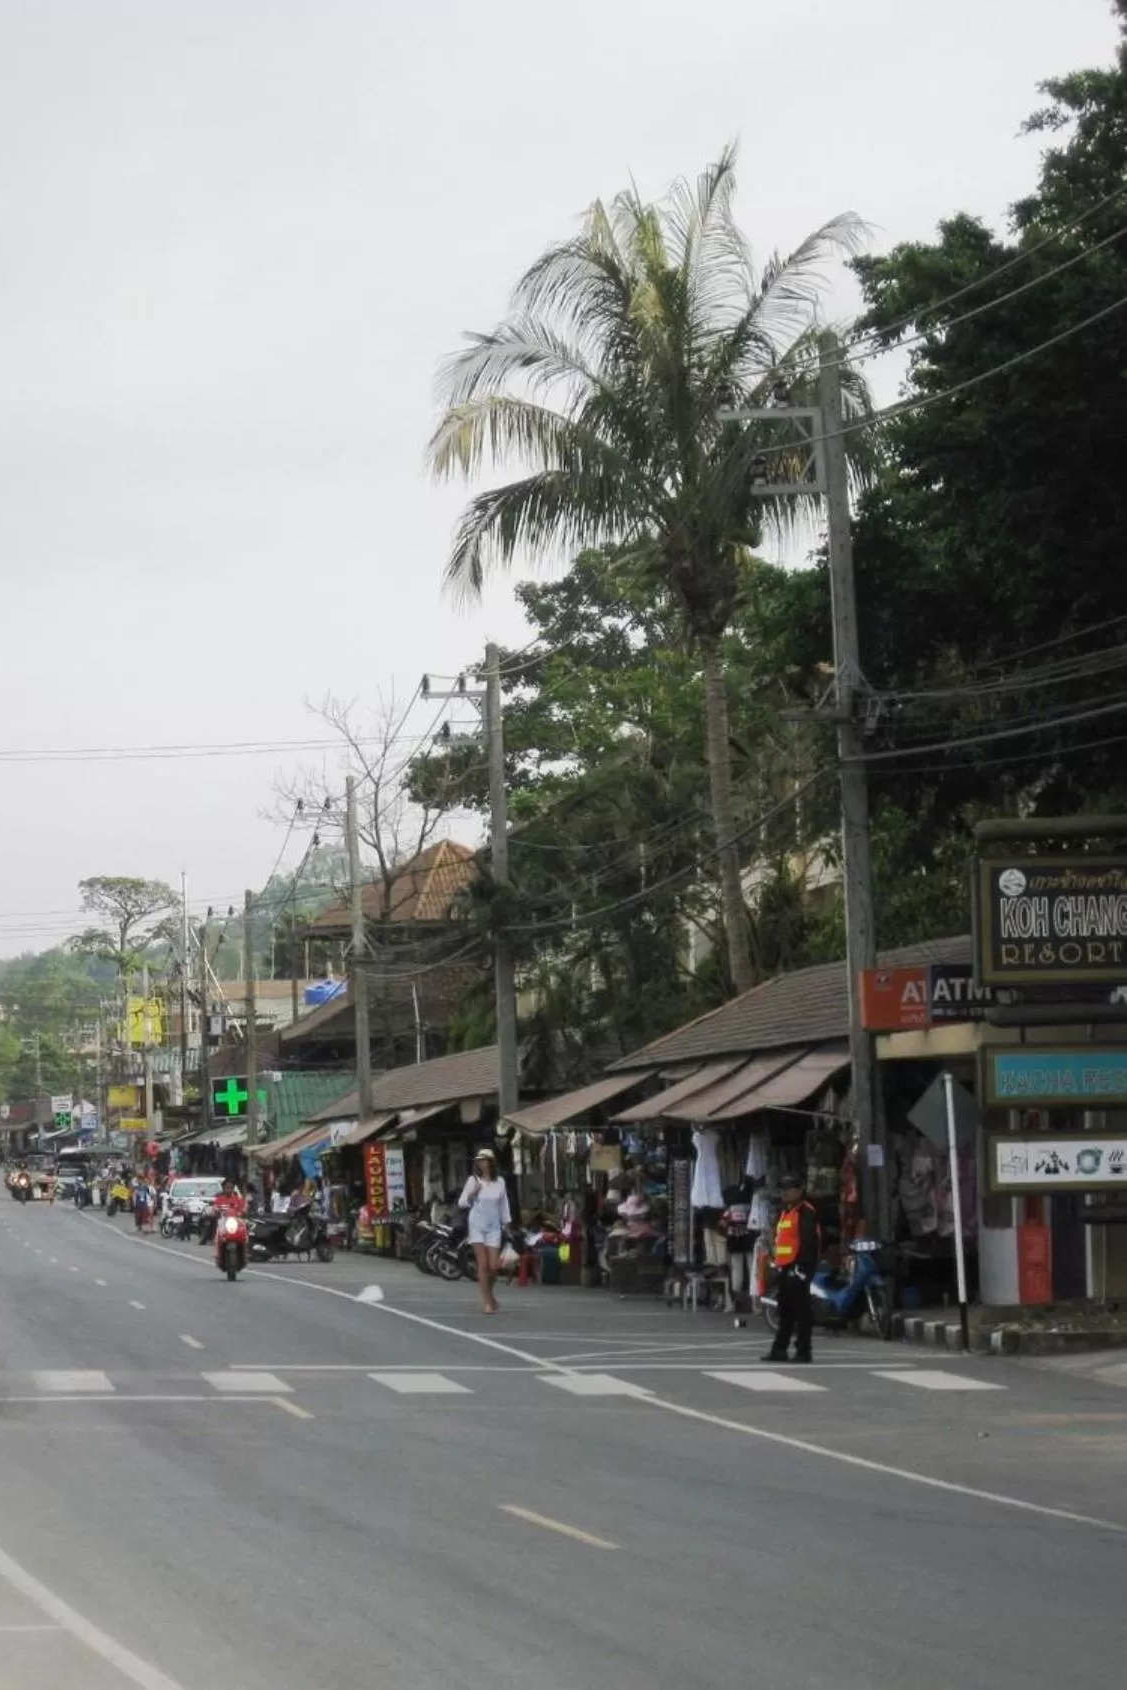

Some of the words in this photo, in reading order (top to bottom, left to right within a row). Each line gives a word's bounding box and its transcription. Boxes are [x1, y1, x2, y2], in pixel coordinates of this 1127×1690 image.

[1000, 896, 1049, 938] KOH
[1054, 894, 1127, 938] CHANG
[1001, 942, 1122, 965] RESORT
[369, 1146, 383, 1214] LAUNDRY
